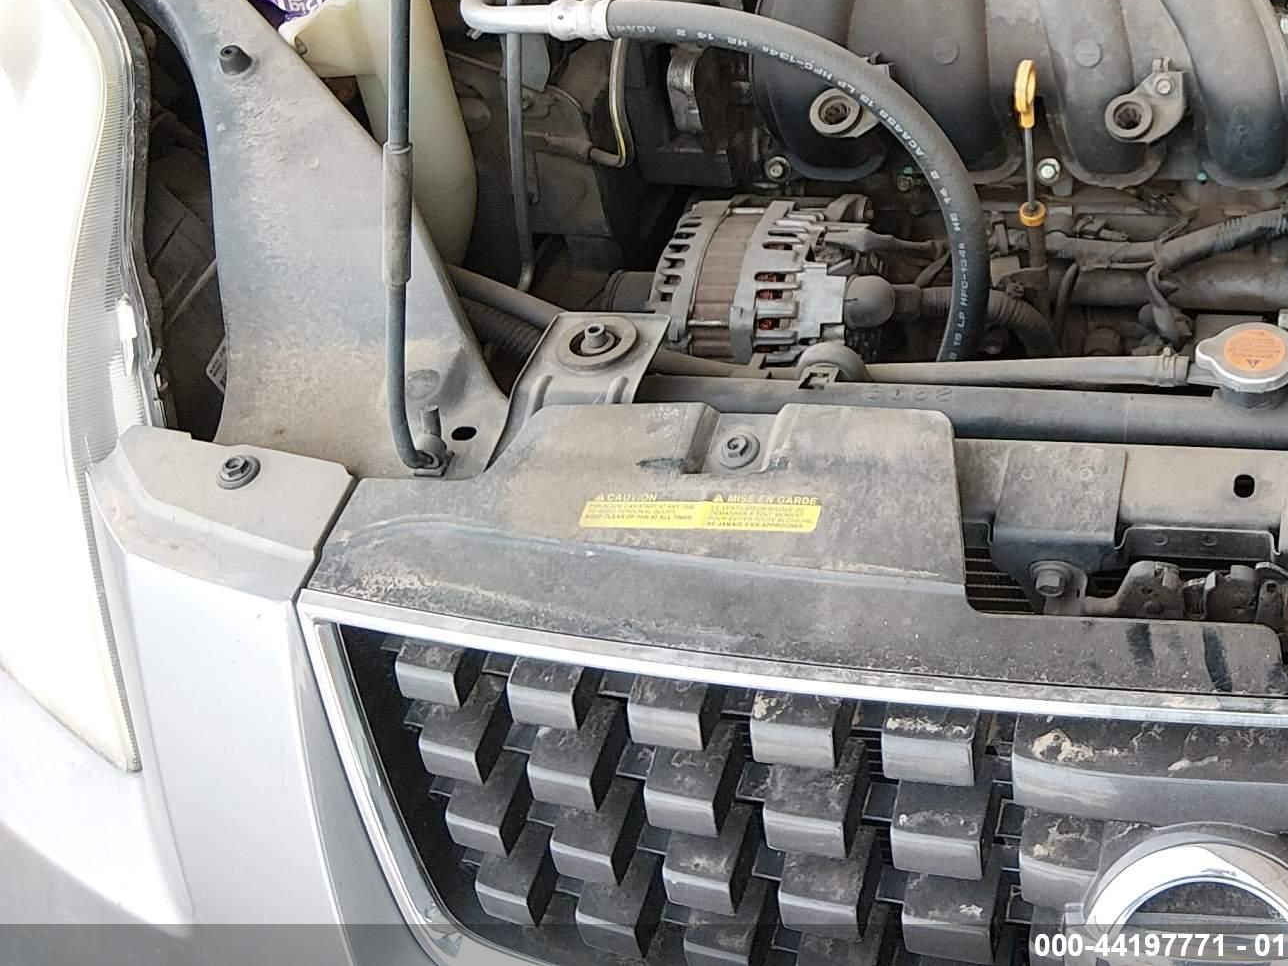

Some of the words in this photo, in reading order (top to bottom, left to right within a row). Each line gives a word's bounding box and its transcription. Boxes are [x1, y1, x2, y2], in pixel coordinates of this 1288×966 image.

[727, 494, 755, 503] MISE
[758, 495, 774, 504] EN
[776, 496, 818, 506] GARDE
